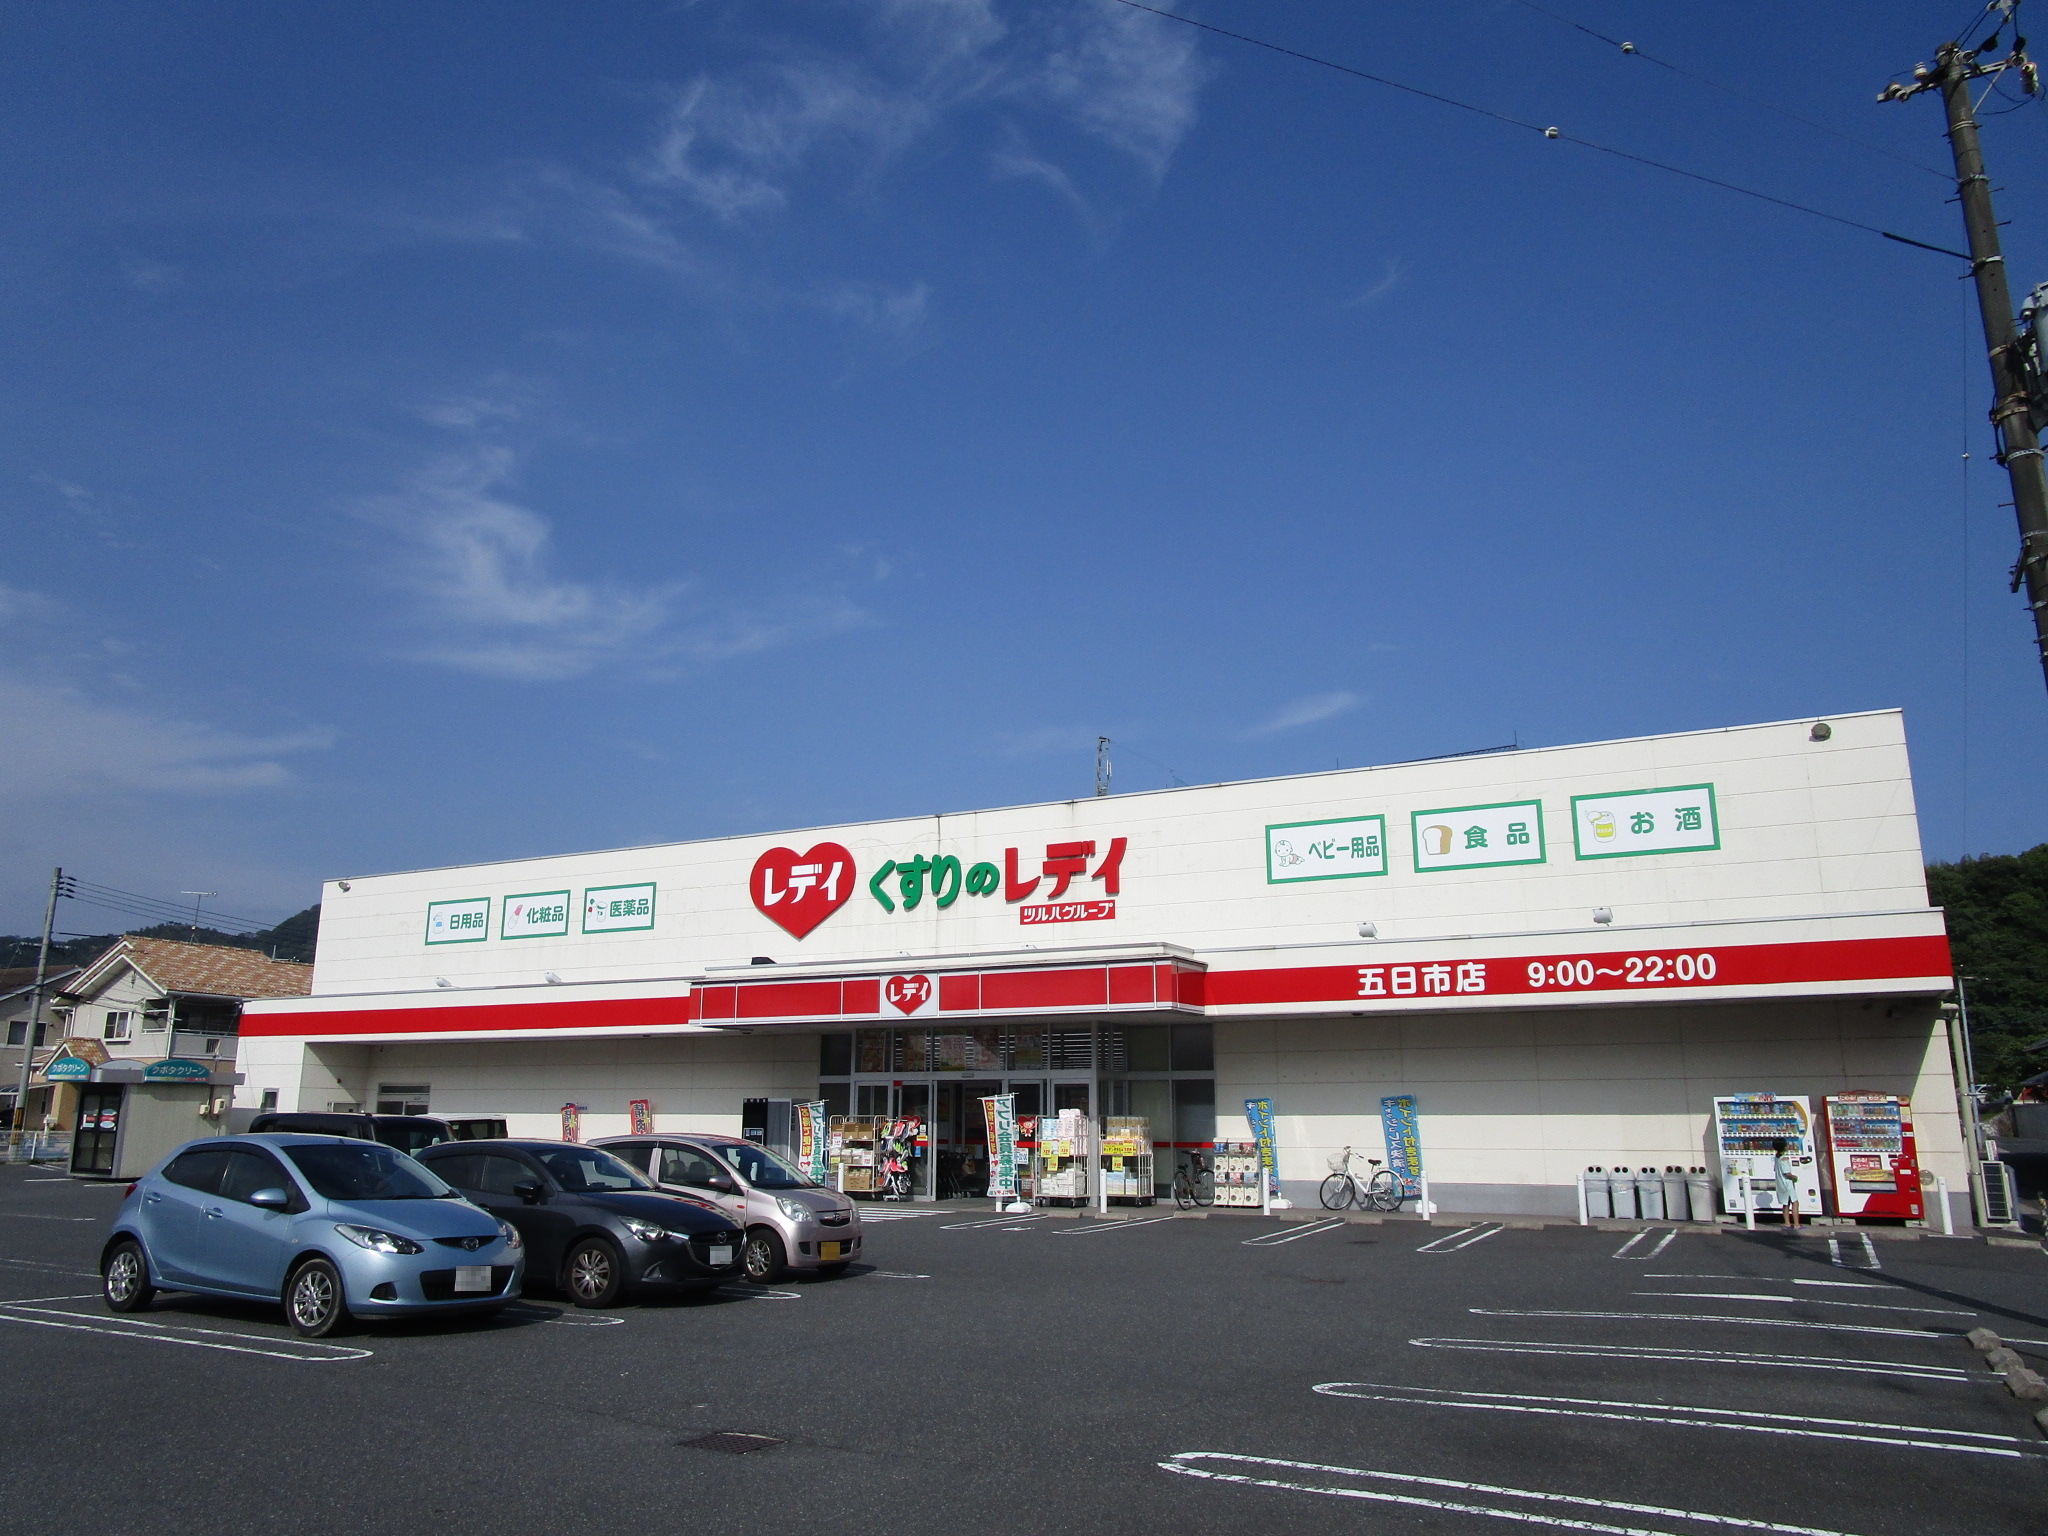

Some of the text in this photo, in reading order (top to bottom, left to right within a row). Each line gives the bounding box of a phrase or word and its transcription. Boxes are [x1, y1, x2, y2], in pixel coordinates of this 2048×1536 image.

[1631, 806, 1702, 834] お 酒
[1463, 823, 1530, 850] 食 品
[1308, 835, 1380, 860] ベビー用品
[764, 861, 843, 906] レディ
[869, 837, 1128, 913] くすりのレディ
[526, 905, 564, 924] 化粧品
[609, 898, 649, 918] 医薬品
[1023, 901, 1114, 922] ツルハグループ
[449, 912, 484, 930] 日用品
[1357, 962, 1486, 996] 五日市店
[890, 983, 928, 1002] レディ
[52, 1063, 86, 1073] クボタクリーン
[152, 1065, 205, 1075] クボタクリーン
